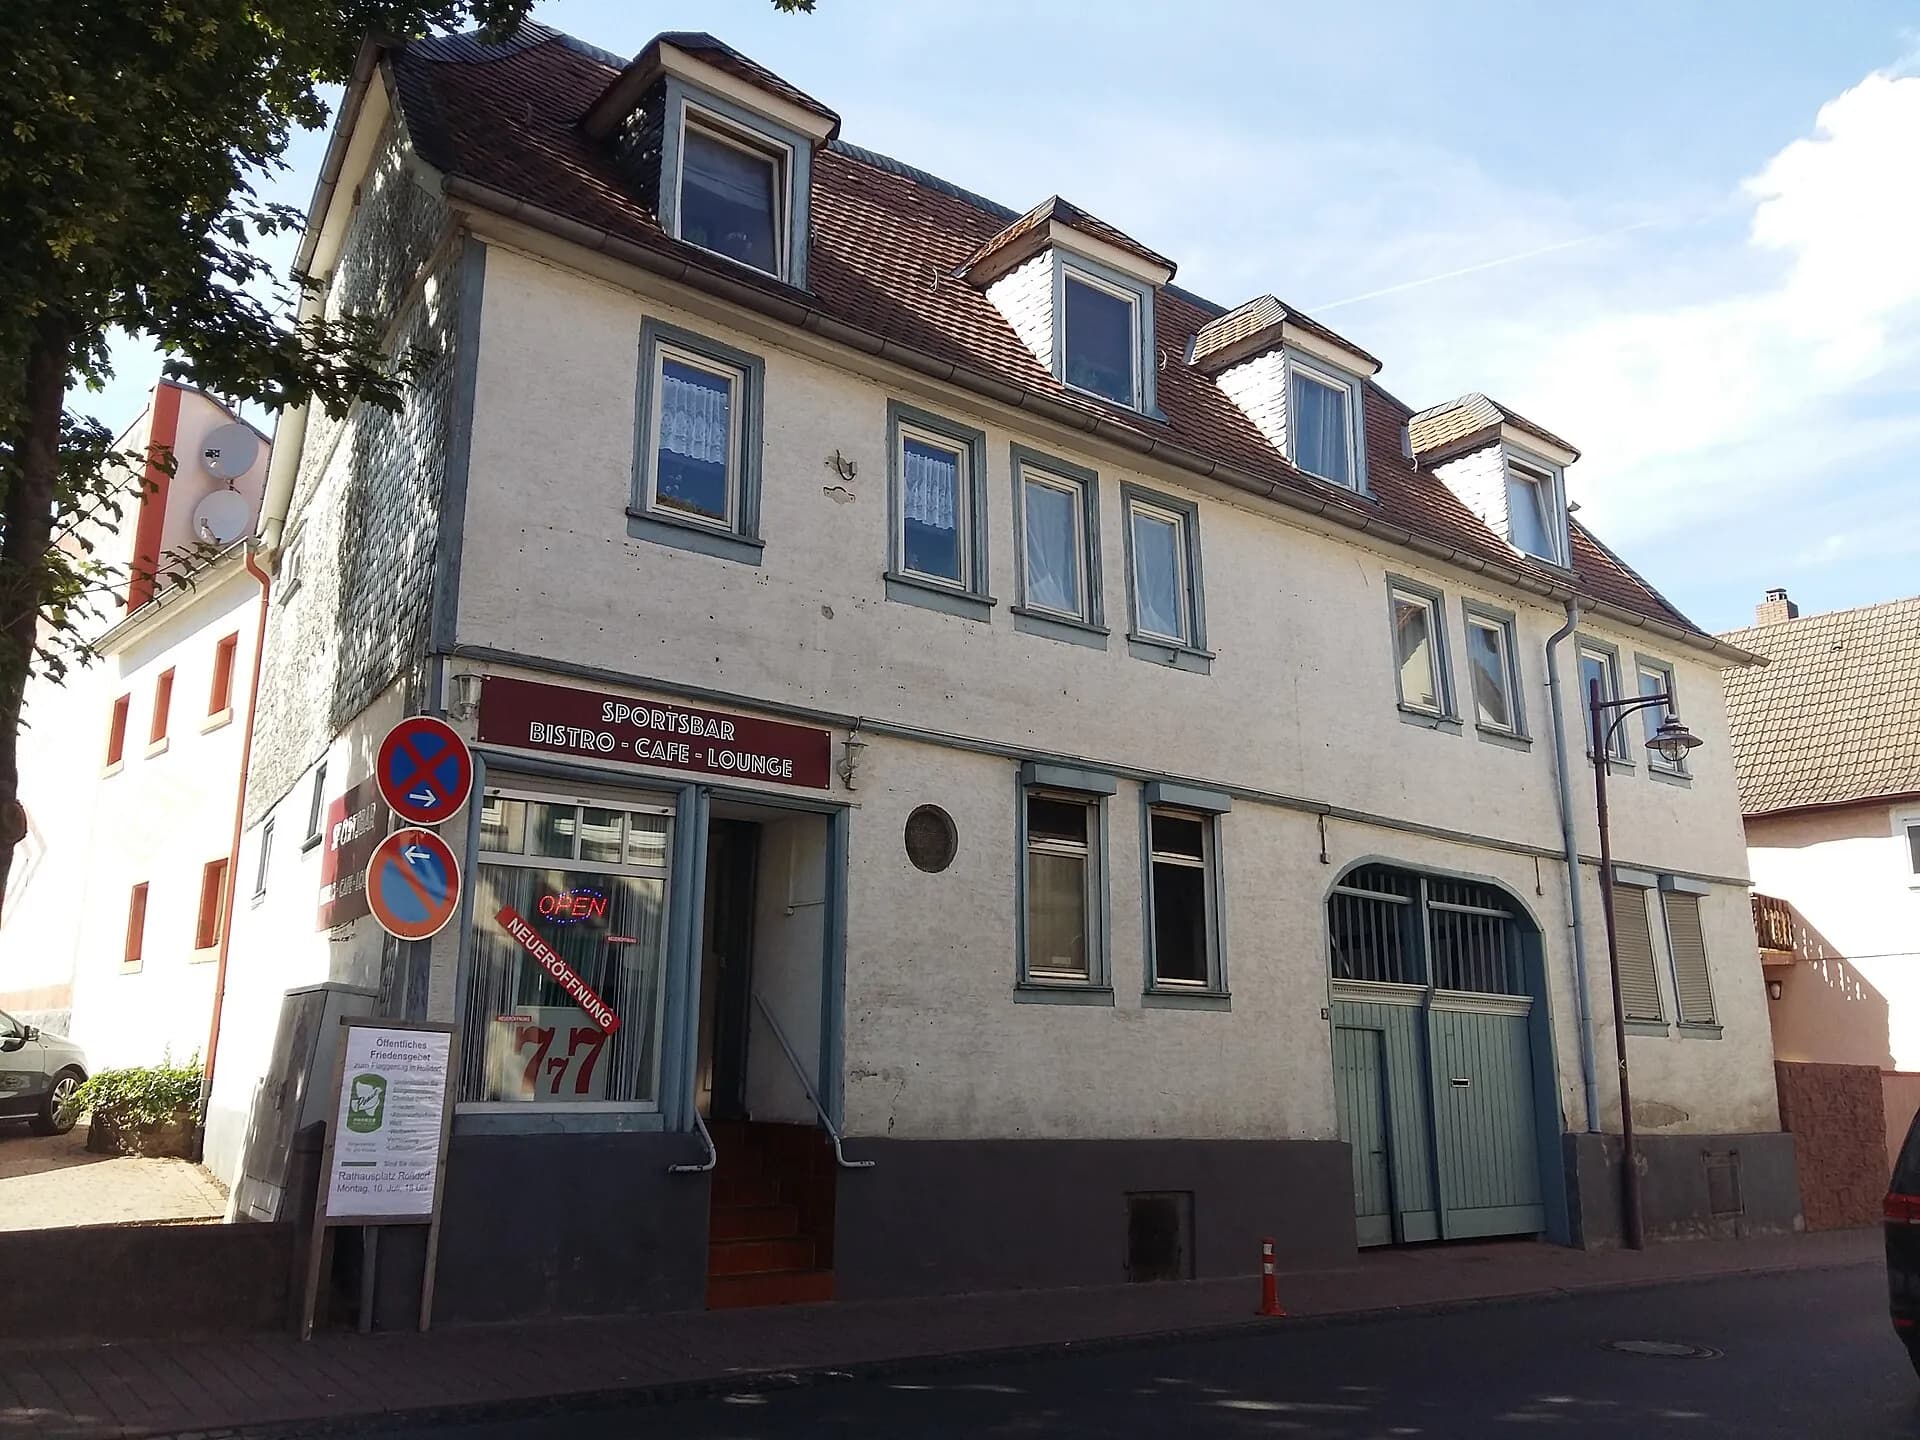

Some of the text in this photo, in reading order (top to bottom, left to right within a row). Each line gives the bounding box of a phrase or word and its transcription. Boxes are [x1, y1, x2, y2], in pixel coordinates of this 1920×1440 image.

[602, 701, 736, 742] SPORTSBAR
[529, 721, 616, 753] BISTRO
[634, 737, 690, 764] CAFE
[707, 748, 794, 779] LOUNGE
[538, 895, 609, 917] OPEN
[507, 916, 614, 1028] NEUERÖFFNUNG
[376, 1037, 427, 1050] Öffentliches
[369, 1050, 431, 1062] Friedensgebet
[338, 1171, 396, 1182] Rathausplatz
